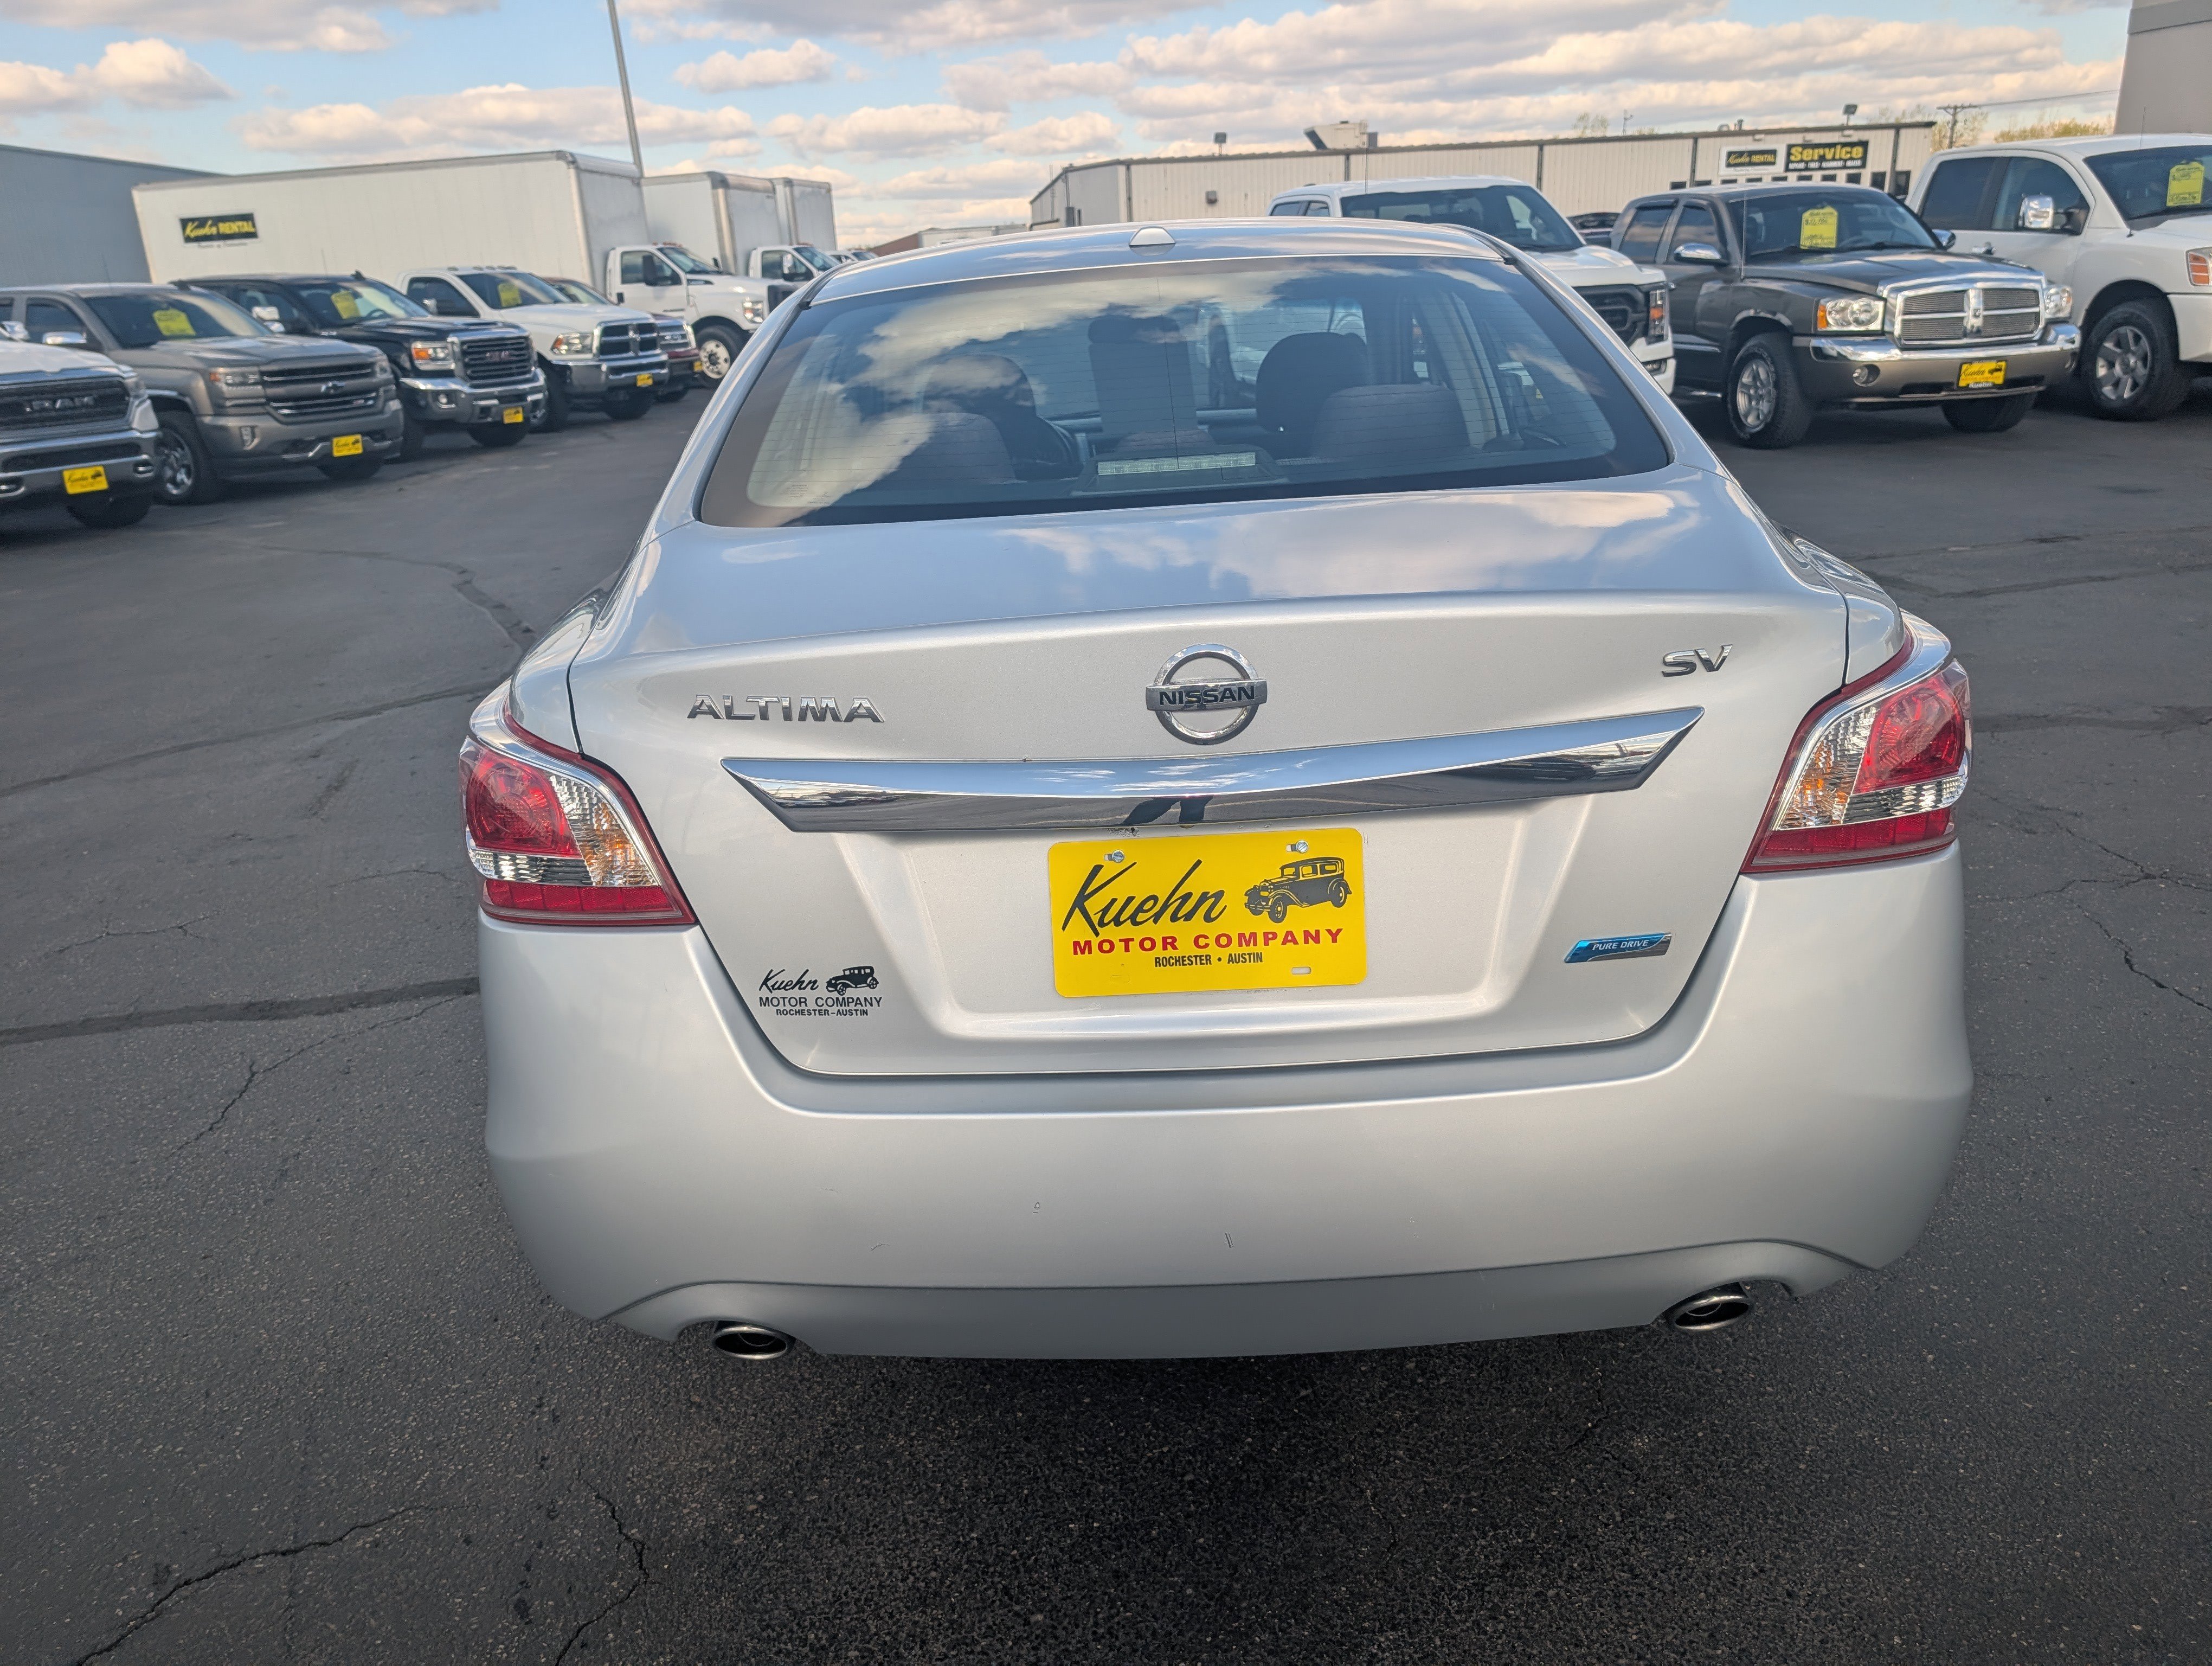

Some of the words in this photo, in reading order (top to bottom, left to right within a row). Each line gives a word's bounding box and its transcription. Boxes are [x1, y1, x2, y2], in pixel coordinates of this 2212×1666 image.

[1751, 153, 1776, 163] RENTAL
[1790, 145, 1863, 161] Service
[1661, 644, 1733, 677] SV
[1159, 685, 1255, 705] NISSAN
[686, 694, 885, 722] ALTIMA
[1061, 858, 1227, 938] Kuehn
[1072, 935, 1179, 956] MOTOR
[1193, 928, 1343, 949] COMPANY
[1592, 943, 1618, 951] PURE
[1620, 939, 1650, 949] DRIVE
[1154, 954, 1212, 967] ROCHESTER
[1227, 952, 1263, 964] AUSTIN
[758, 969, 819, 994] Kuehn
[758, 996, 808, 1008] MOTOR
[815, 996, 883, 1008] COMPANY
